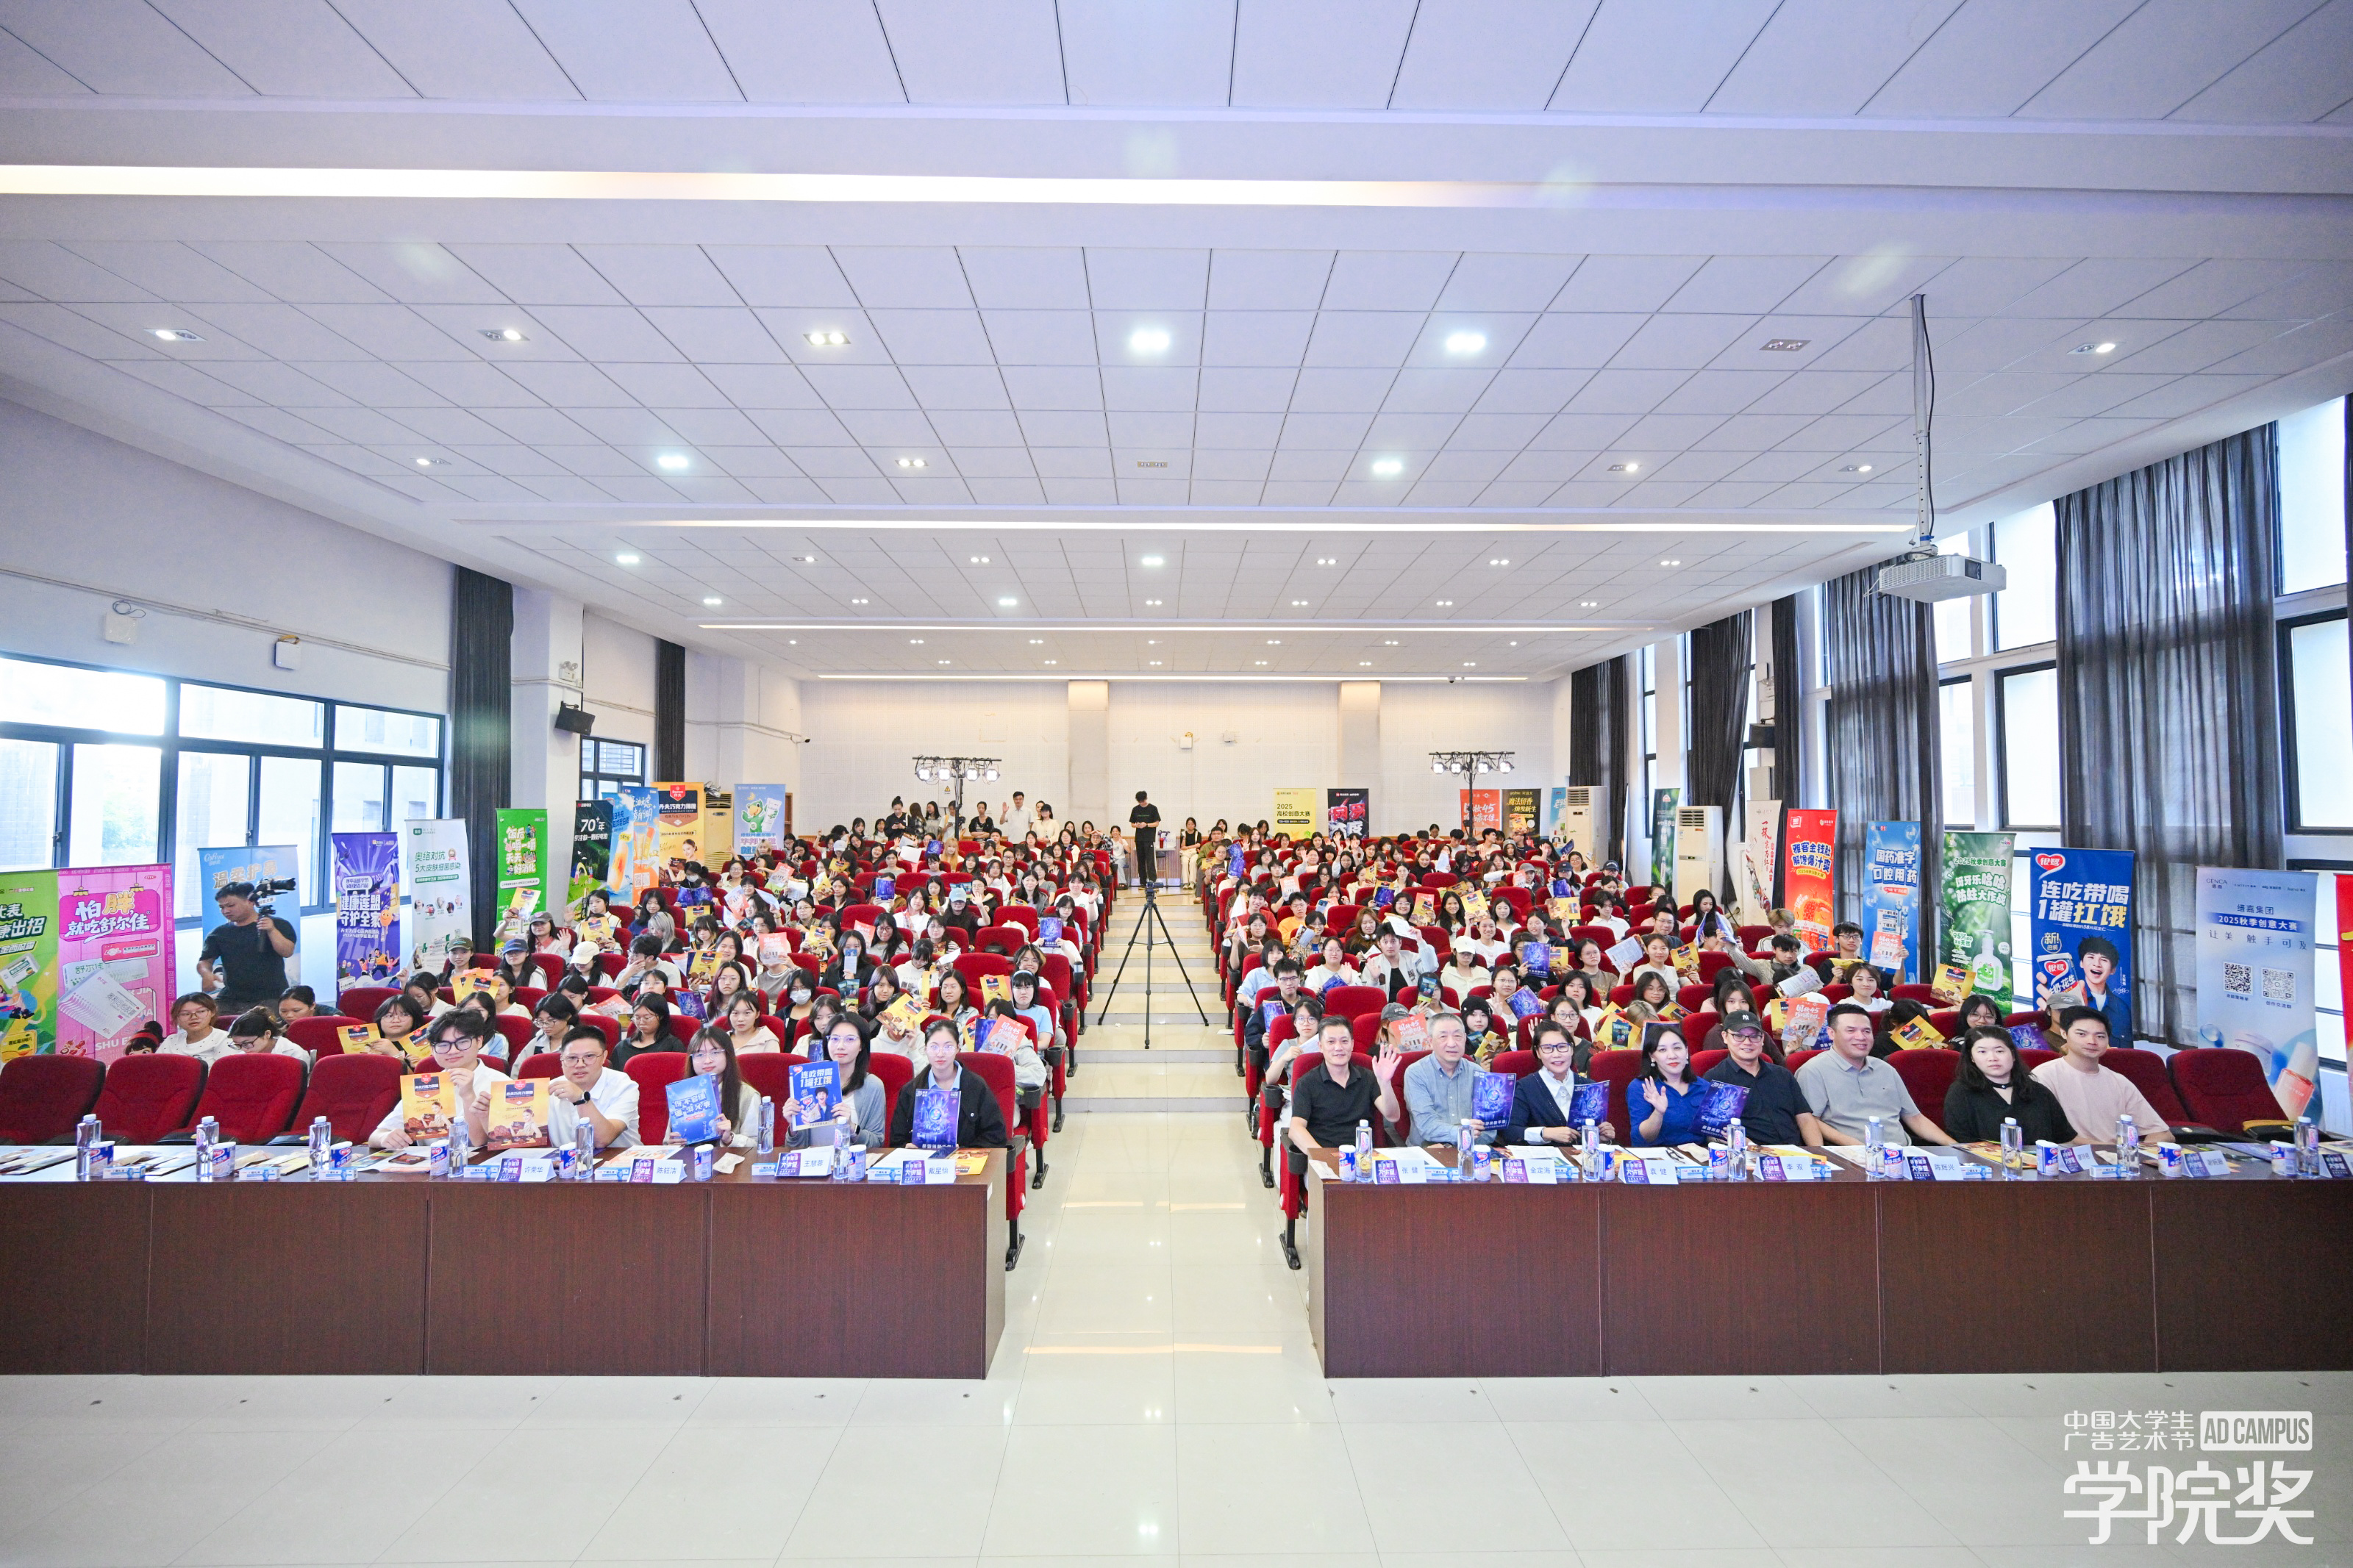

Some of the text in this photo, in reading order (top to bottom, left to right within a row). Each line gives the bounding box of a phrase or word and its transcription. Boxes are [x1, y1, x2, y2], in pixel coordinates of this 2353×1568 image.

[507, 828, 524, 840] 饭后
[1792, 842, 1831, 856] 雅客金钱肚
[415, 851, 446, 862] 奥络对抗
[507, 853, 521, 864] 天天
[1876, 849, 1915, 864] 国药准字
[1954, 858, 2007, 867] 2025秋季创意大赛
[2040, 857, 2060, 867] 银鹭
[415, 864, 462, 873] 5大皮肤细菌感染
[514, 864, 535, 875] 好消化
[1792, 854, 1831, 873] 解馋爆汁爽
[1873, 867, 1917, 885] 口腔用药
[2040, 881, 2129, 905] 连吃带喝
[340, 911, 381, 928] 守护全家
[2038, 899, 2127, 928] 1罐扛饿
[65, 912, 150, 942] 就吃舒尔佳
[2218, 916, 2297, 931] 2025秋季创意大赛
[2044, 932, 2059, 944] 新!
[2247, 934, 2307, 950] 触手可及
[2048, 964, 2065, 973] 银鹭
[96, 1038, 119, 1050] SHU
[801, 1067, 832, 1079] 连吃带喝
